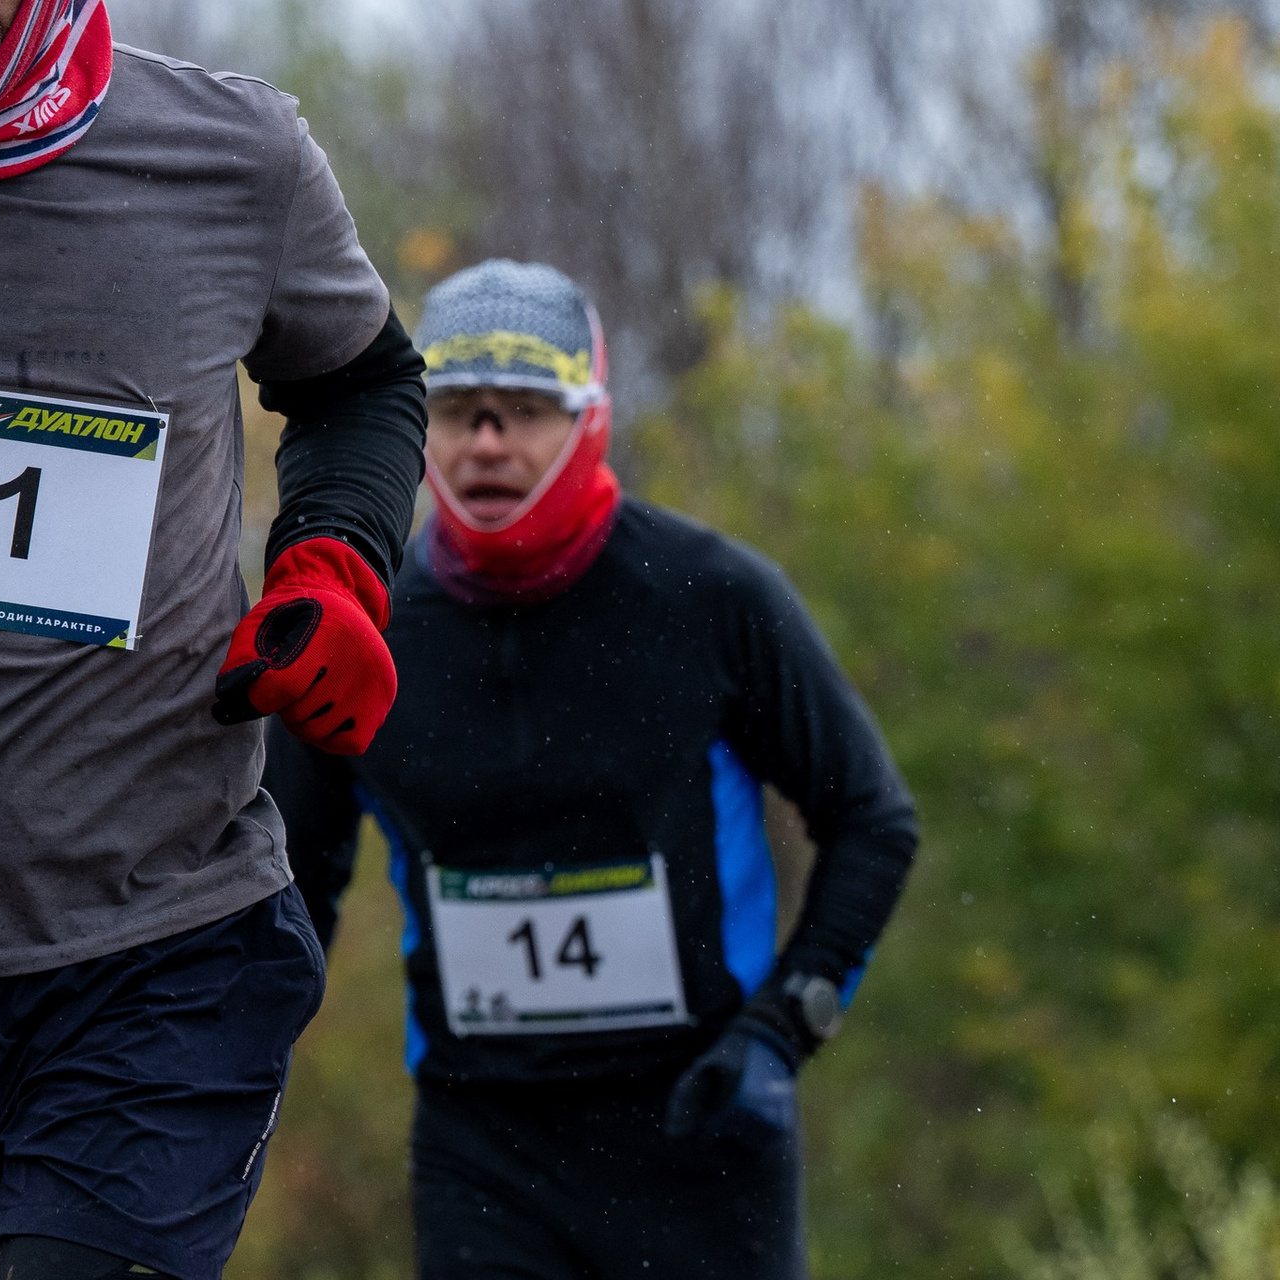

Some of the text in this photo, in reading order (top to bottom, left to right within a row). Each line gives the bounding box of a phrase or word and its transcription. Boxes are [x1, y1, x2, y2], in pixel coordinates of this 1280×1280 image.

[6, 406, 146, 443] ДУАТЛОН
[36, 616, 106, 634] ХАРАКТЕР.
[506, 913, 602, 981] 14
